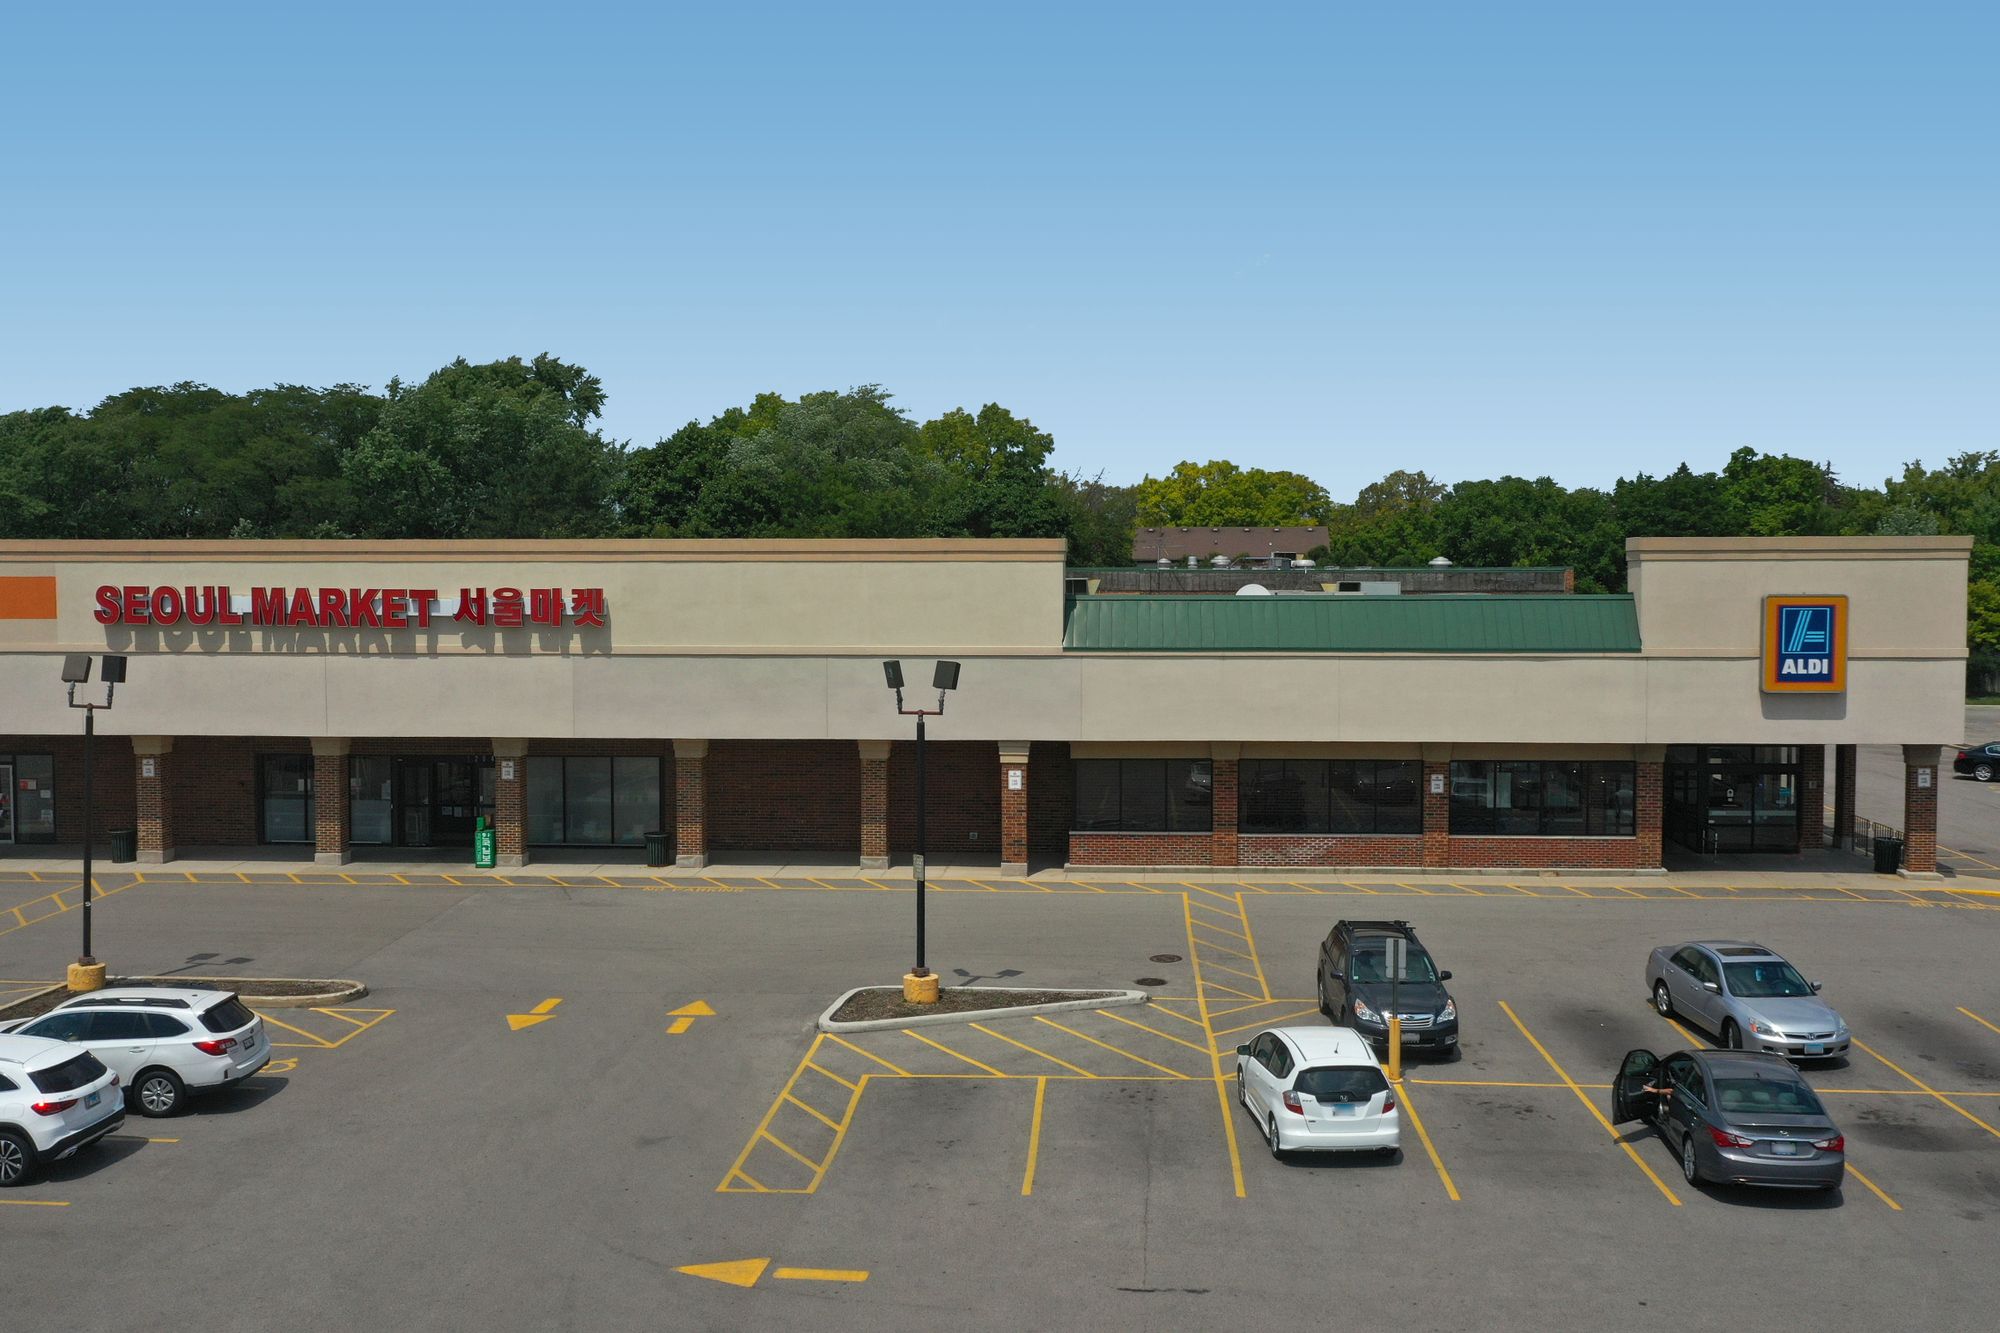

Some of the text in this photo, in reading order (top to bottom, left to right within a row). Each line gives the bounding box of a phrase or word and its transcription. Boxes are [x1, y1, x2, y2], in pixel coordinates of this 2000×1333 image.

[94, 585, 438, 629] SEOUL MARKET
[453, 587, 605, 628] 서울마켓
[1781, 658, 1829, 675] ALDI
